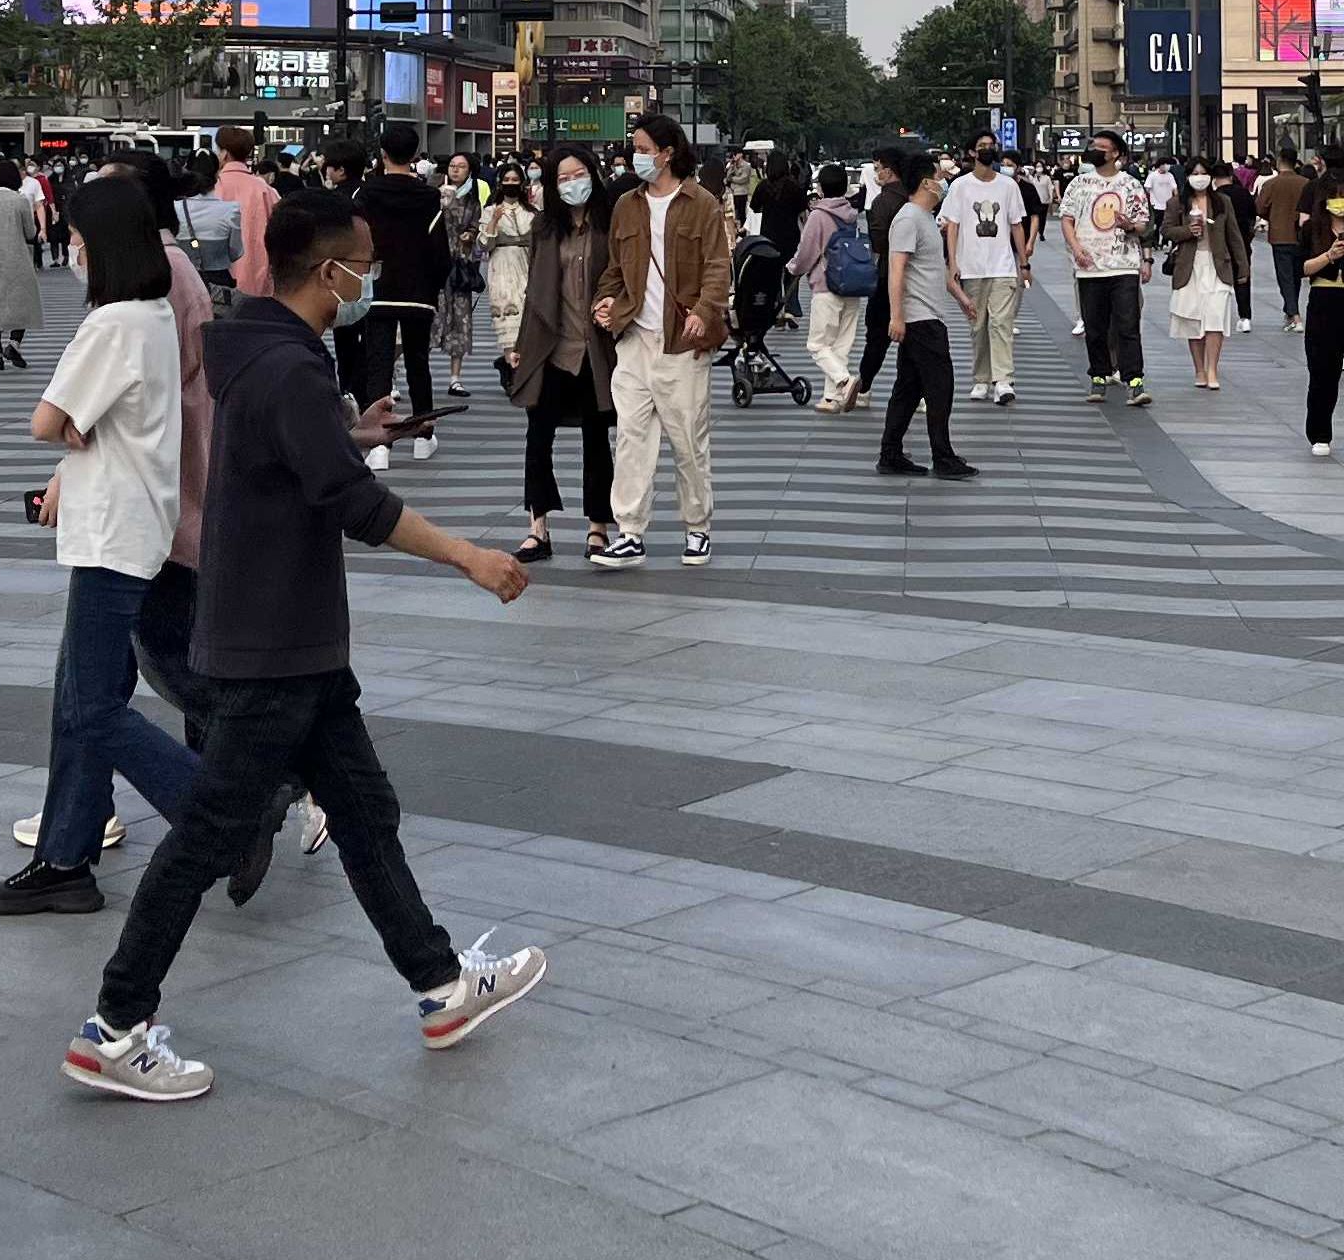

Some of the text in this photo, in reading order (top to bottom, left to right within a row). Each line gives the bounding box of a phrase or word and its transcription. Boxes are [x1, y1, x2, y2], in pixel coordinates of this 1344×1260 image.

[256, 49, 330, 73] 波司登
[476, 974, 496, 996] N
[130, 1051, 158, 1074] N
